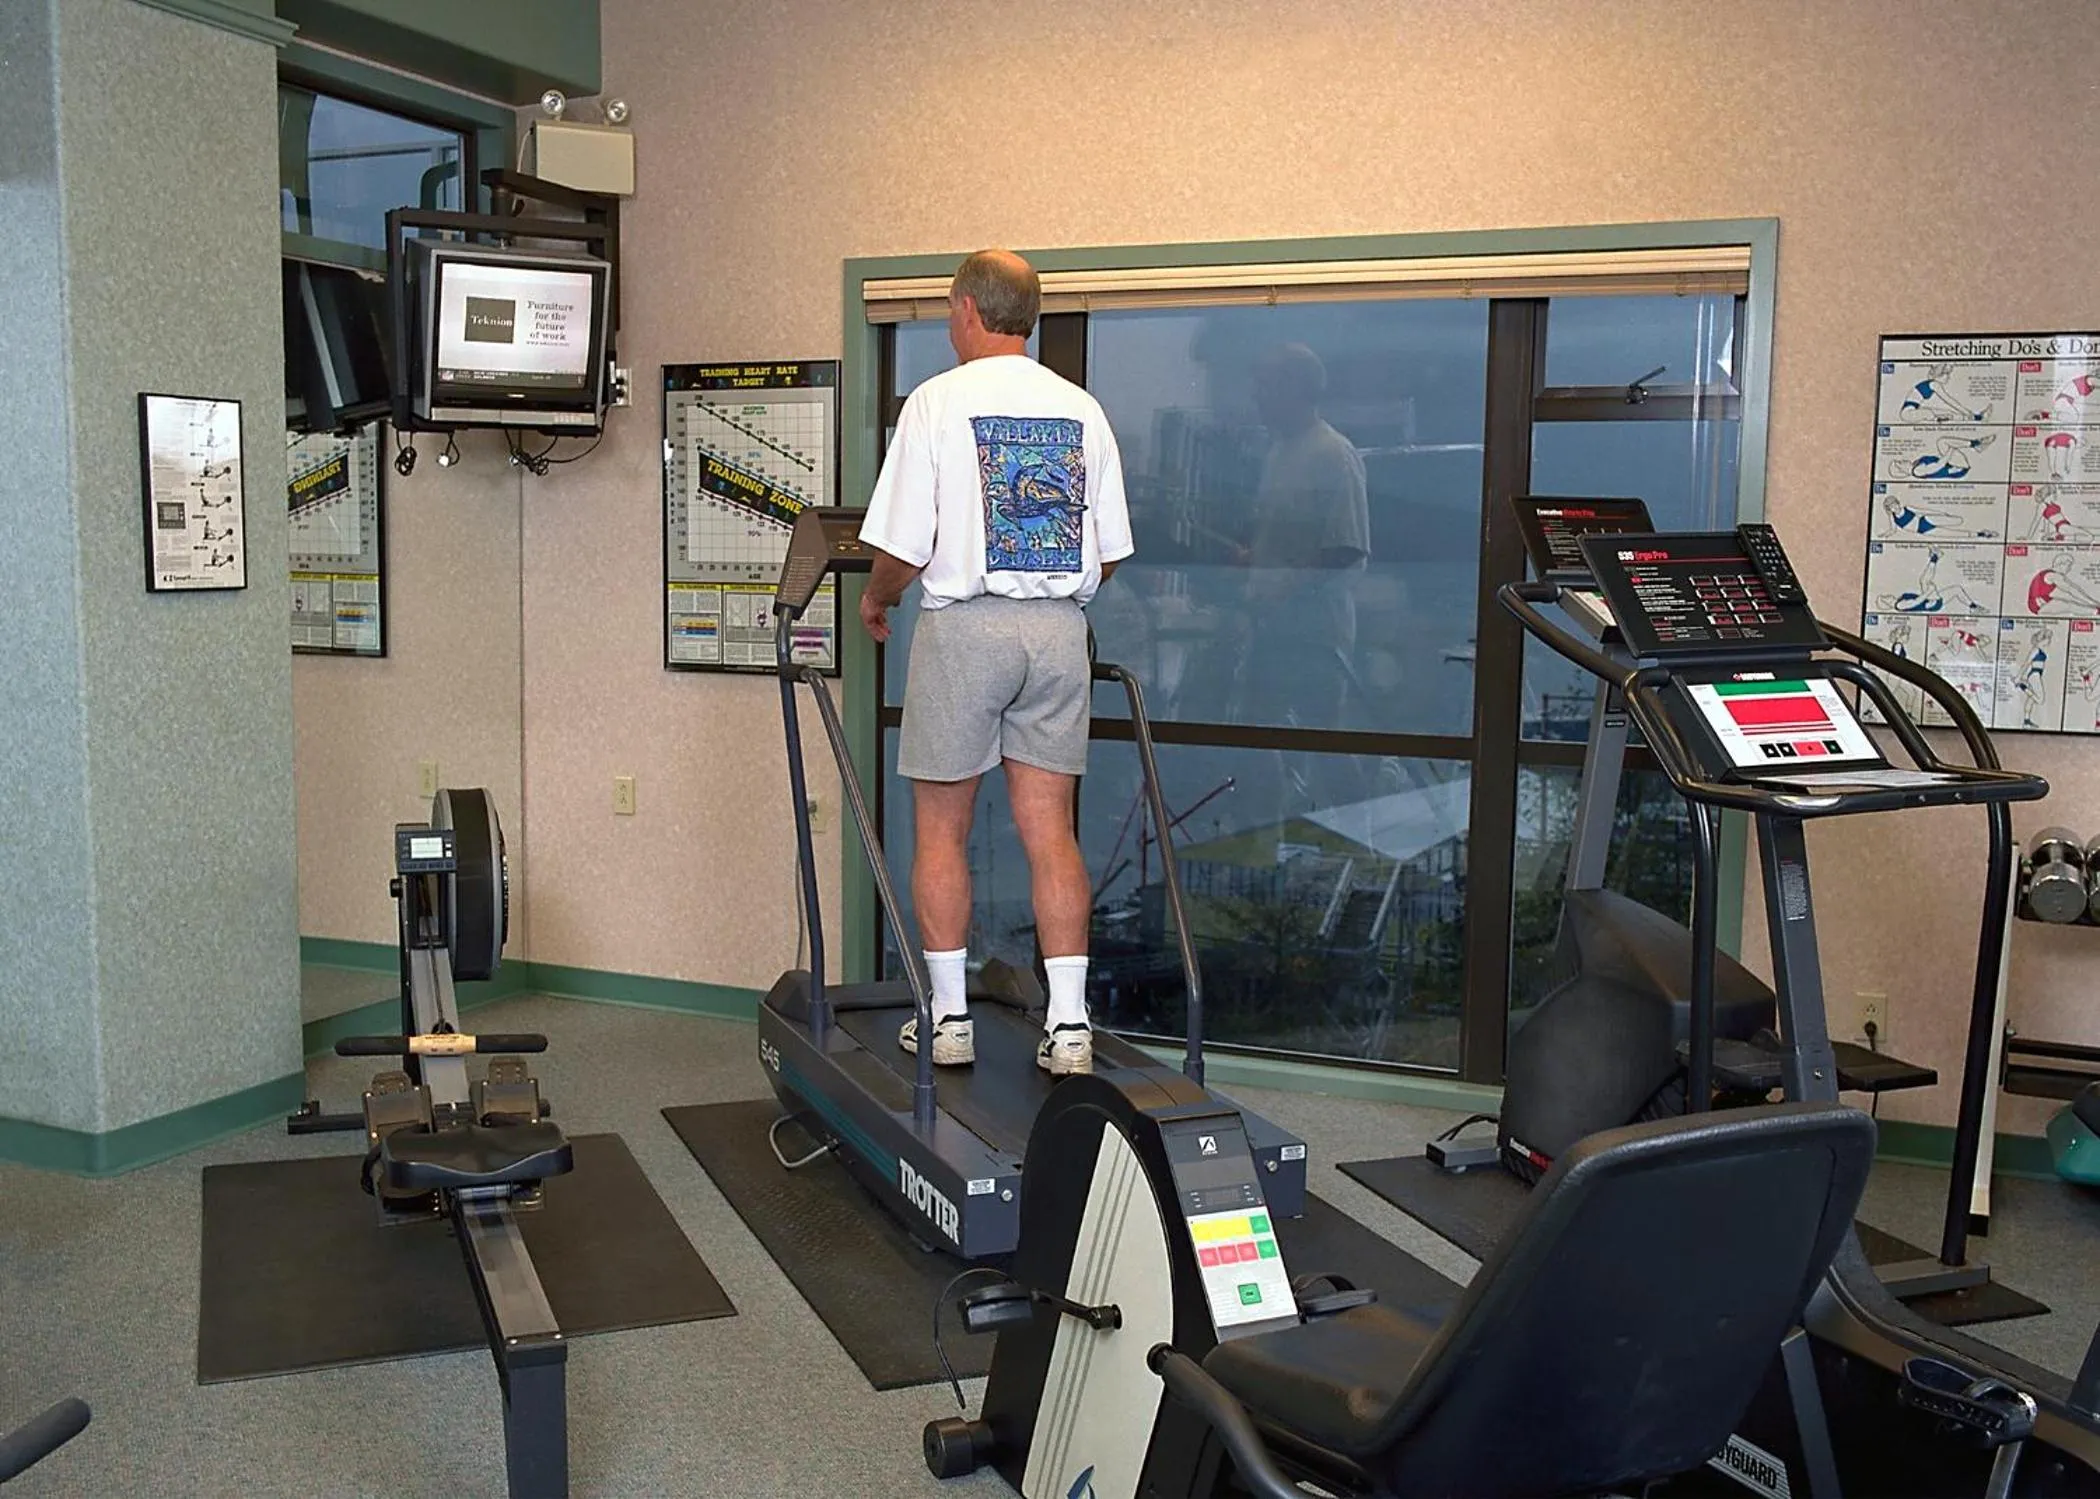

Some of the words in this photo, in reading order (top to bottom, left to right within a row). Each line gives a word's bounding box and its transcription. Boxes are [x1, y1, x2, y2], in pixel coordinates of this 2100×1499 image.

[528, 301, 574, 312] Furniture
[470, 314, 513, 327] Teknion
[535, 312, 549, 321] for
[551, 313, 567, 321] the
[535, 322, 565, 331] future
[530, 332, 541, 340] of
[543, 332, 566, 340] work
[1921, 341, 2002, 358] Stretching
[2009, 340, 2041, 355] Do's
[2046, 340, 2064, 355] &
[700, 368, 739, 378] TRAINING
[744, 367, 771, 376] HEART
[776, 366, 799, 374] RATE
[733, 377, 765, 386] TARGET
[708, 460, 765, 496] TRAINING
[769, 490, 803, 514] ZONE
[899, 1156, 960, 1246] TROTTER
